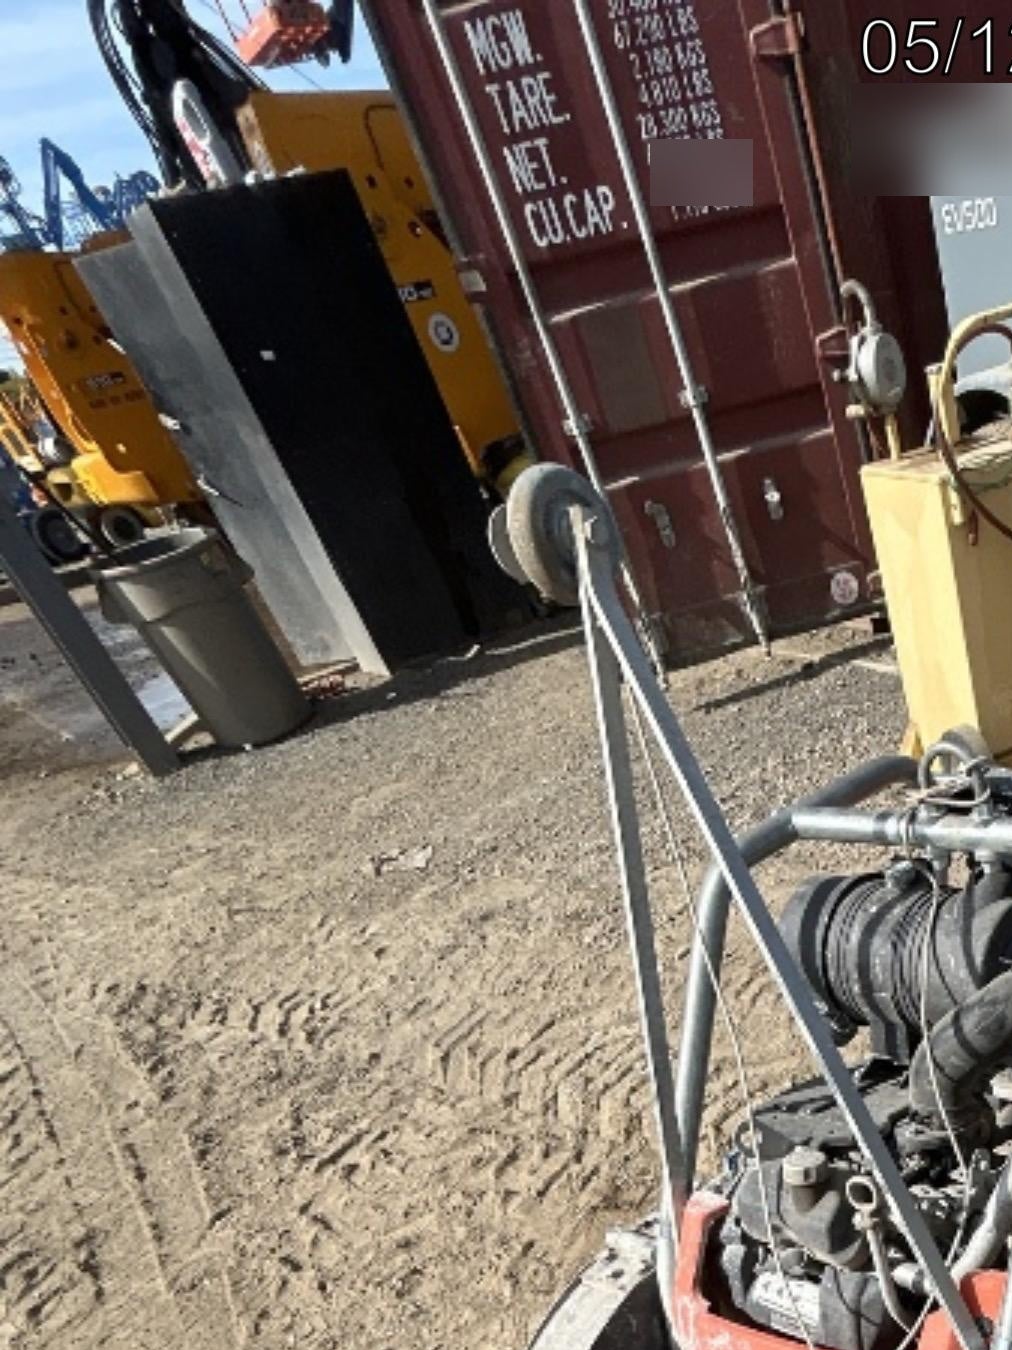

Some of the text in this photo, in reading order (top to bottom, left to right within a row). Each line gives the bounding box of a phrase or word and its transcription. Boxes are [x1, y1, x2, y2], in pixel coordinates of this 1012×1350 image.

[464, 8, 543, 76] MGW.
[485, 71, 571, 135] TARE.
[503, 137, 568, 195] NET.
